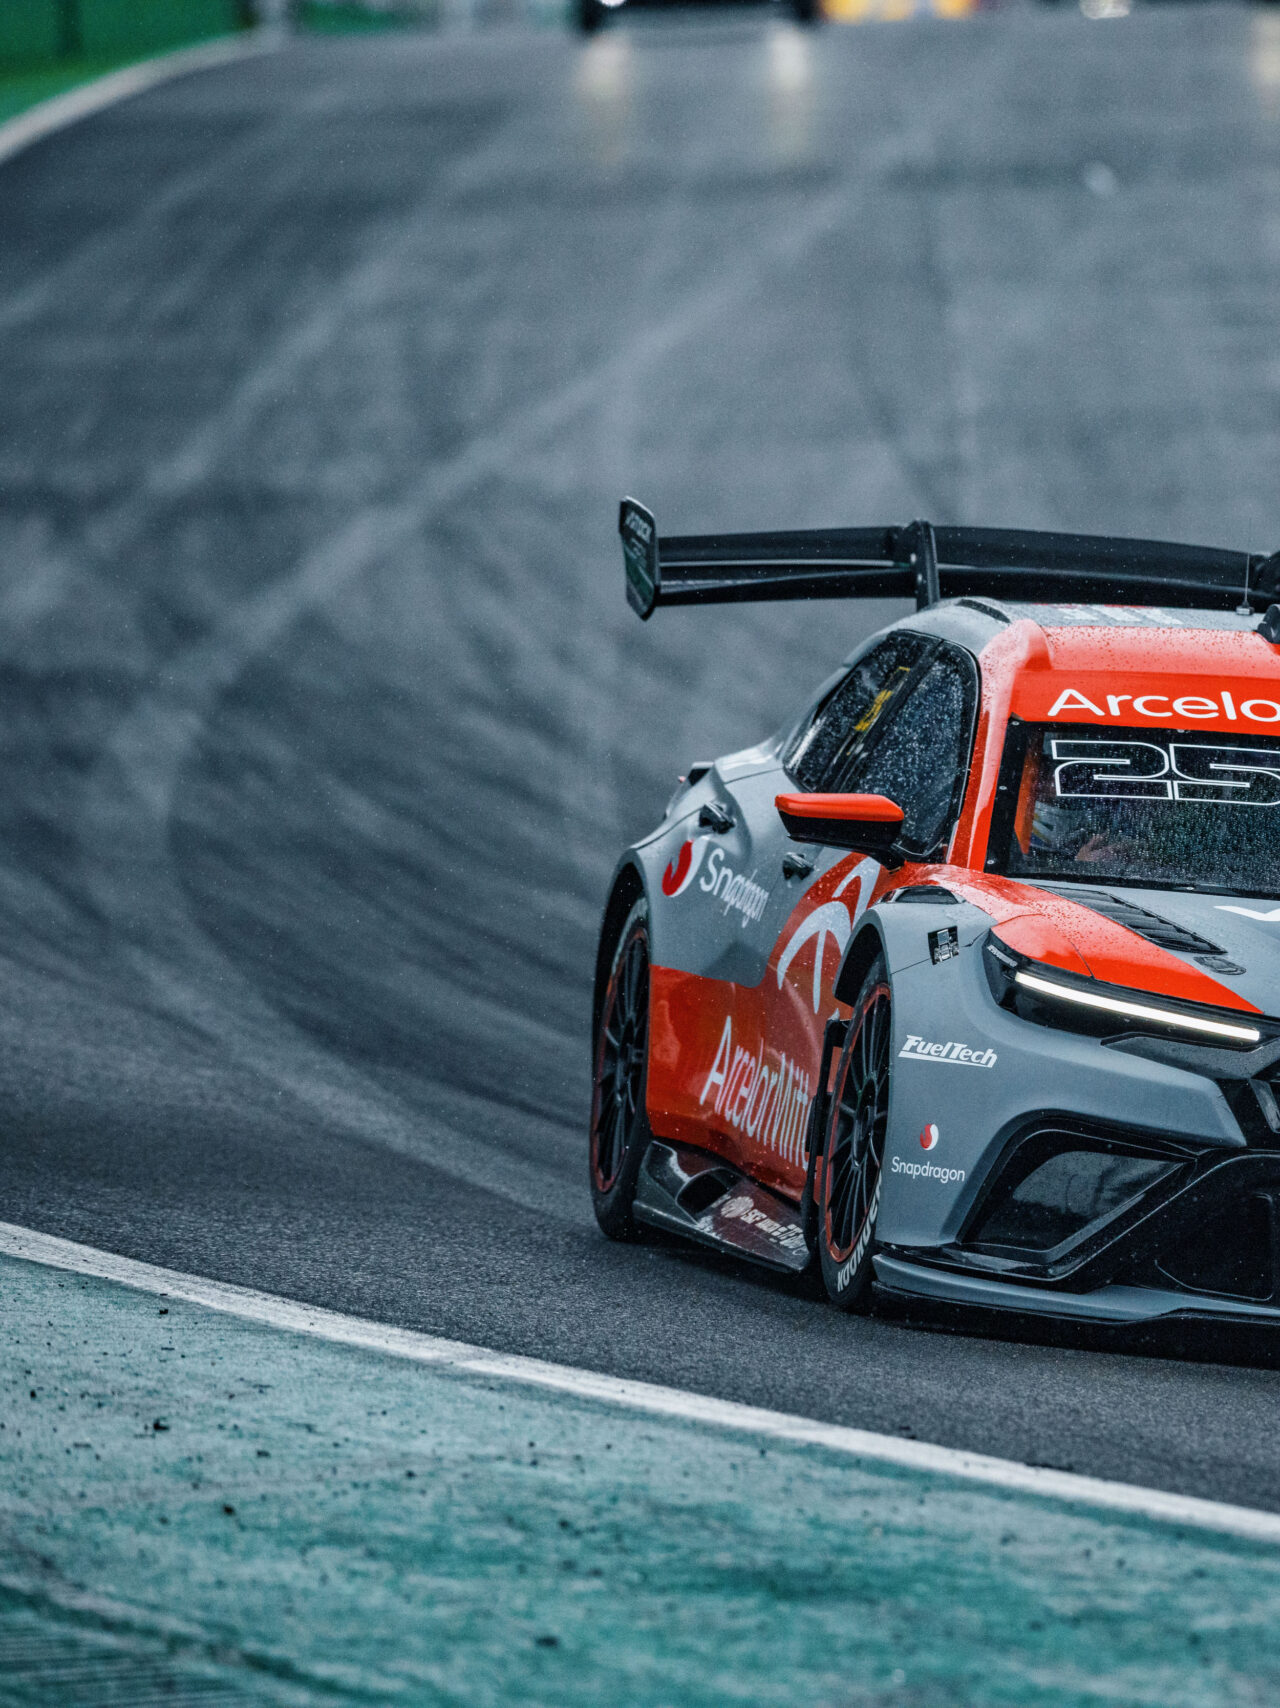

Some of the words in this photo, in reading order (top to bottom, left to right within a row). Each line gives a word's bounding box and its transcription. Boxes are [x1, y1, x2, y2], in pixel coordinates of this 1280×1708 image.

[900, 1034, 998, 1068] FuelTech
[700, 1015, 810, 1172] ArcelorMitt
[890, 1156, 965, 1184] Snapdragon
